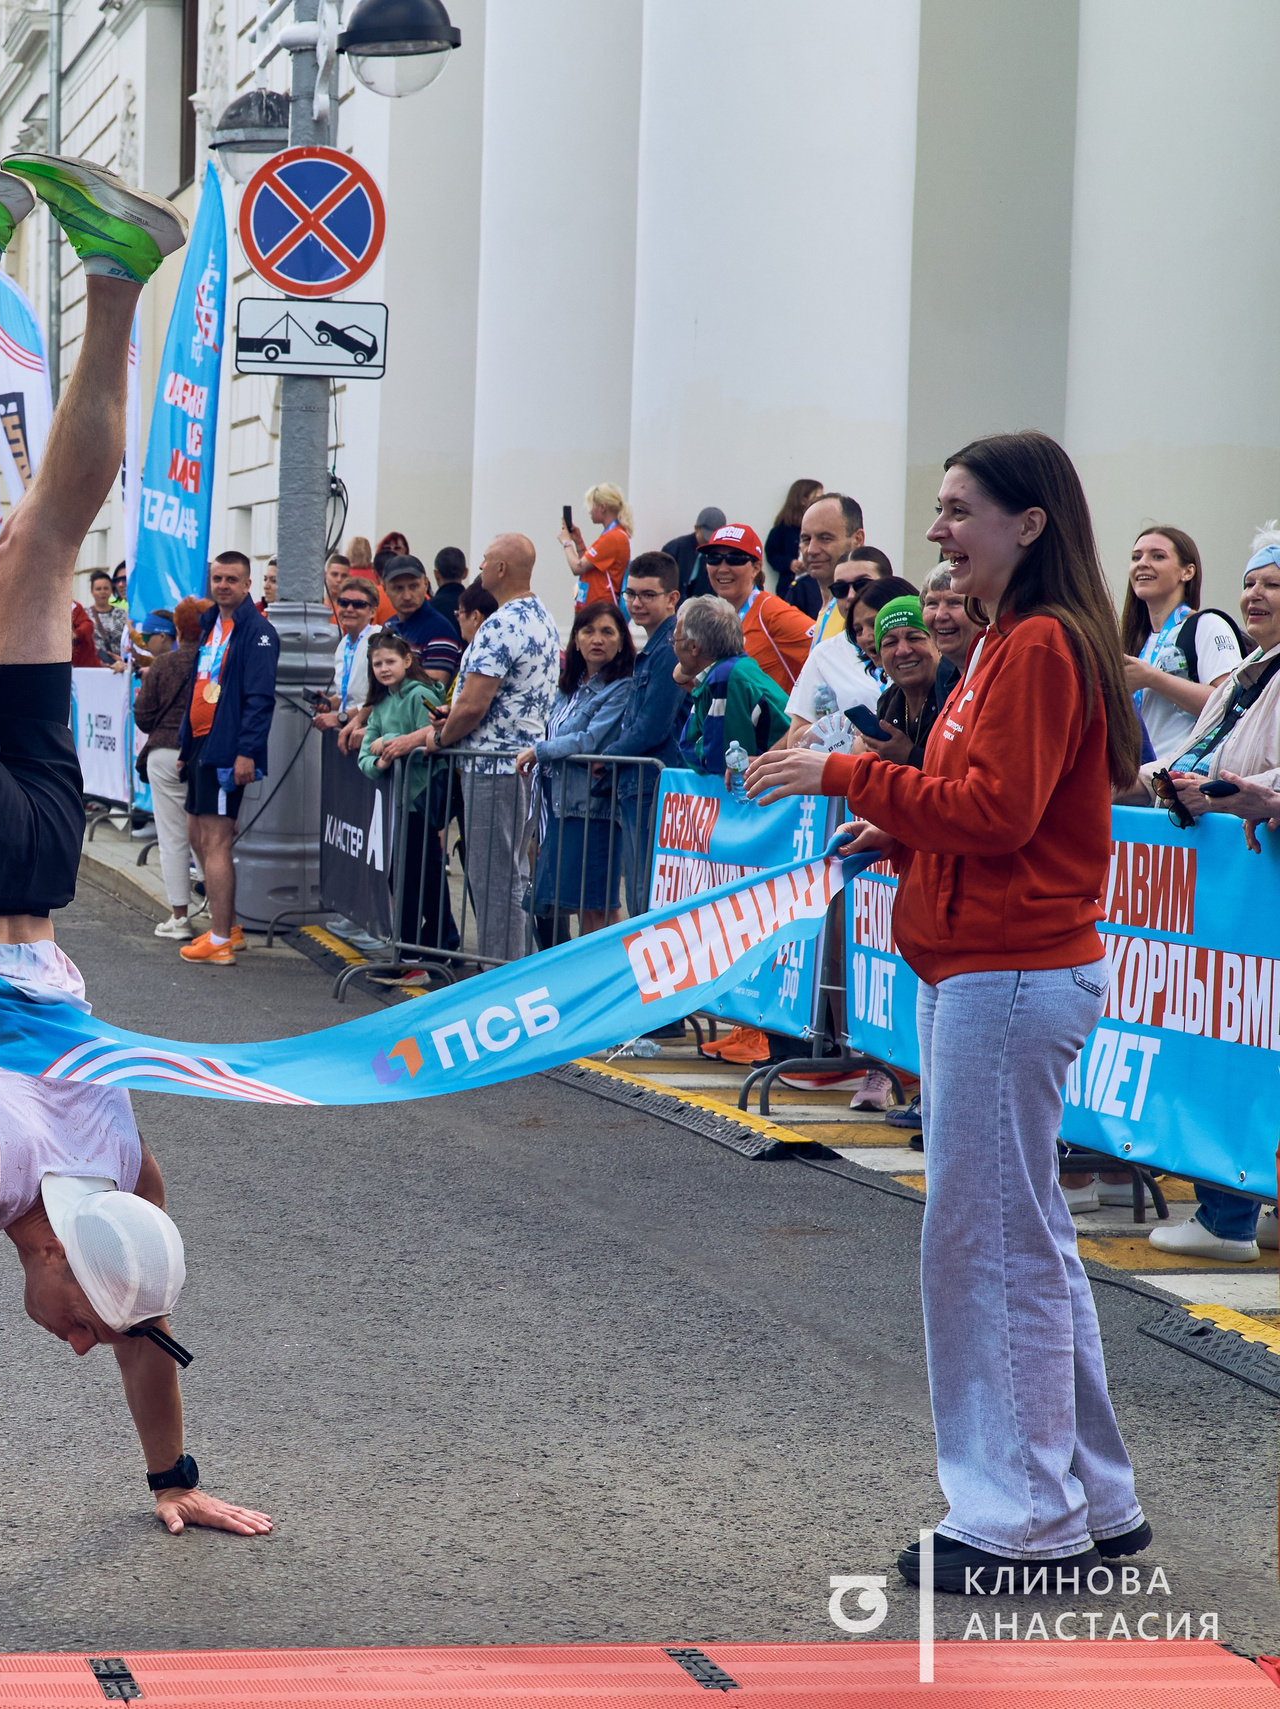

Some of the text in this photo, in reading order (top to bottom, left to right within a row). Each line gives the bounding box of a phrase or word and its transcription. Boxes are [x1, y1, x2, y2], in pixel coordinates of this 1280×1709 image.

[324, 814, 363, 858] КЛАСТЕР
[853, 877, 898, 954] РЕКОР
[1098, 841, 1196, 934] ТАВИМ
[853, 951, 866, 1022] 10
[867, 956, 896, 1032] ЛЕТ
[1100, 932, 1216, 1038] КОРДЫ
[430, 986, 561, 1070] ПСБ
[1084, 1027, 1162, 1122] ЛЕТ
